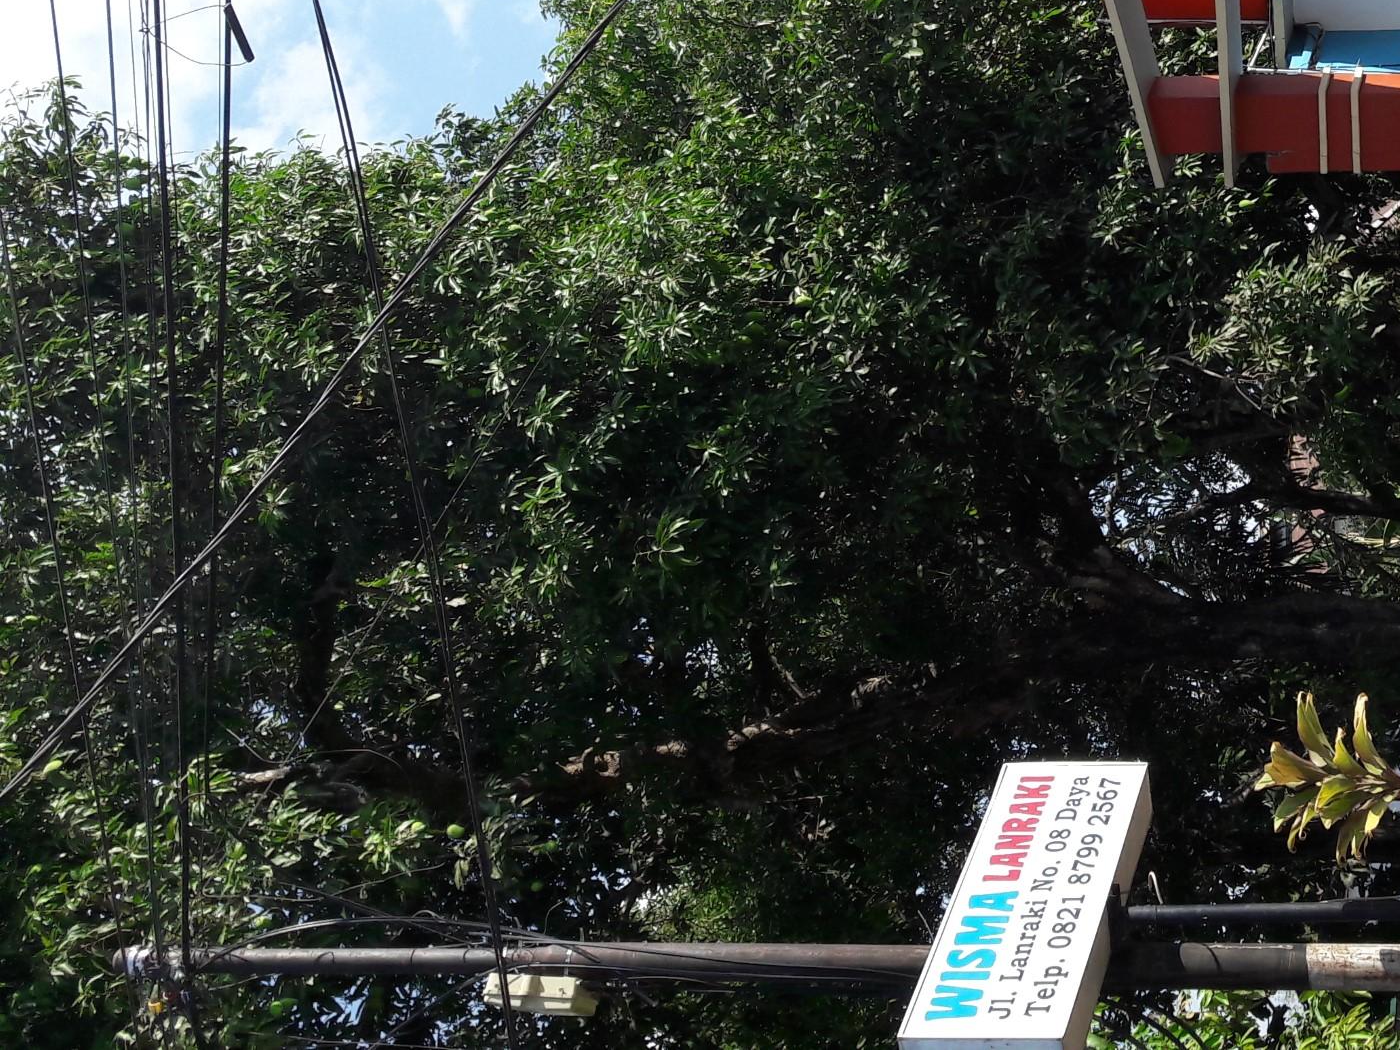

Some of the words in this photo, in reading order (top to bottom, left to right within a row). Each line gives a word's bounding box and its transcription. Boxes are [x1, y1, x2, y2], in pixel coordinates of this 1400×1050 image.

[1056, 776, 1090, 822] Daya
[1045, 827, 1071, 852] 08
[925, 890, 1019, 1021] WISMA
[982, 775, 1055, 881] LANRAKI
[1025, 958, 1069, 1017] Telp.
[1047, 894, 1085, 949] 0821
[1068, 833, 1103, 884] 8799
[1088, 777, 1121, 826] 2567
[1030, 860, 1061, 892] No.
[999, 899, 1048, 981] Lanraki
[988, 991, 1017, 1019] Jl.
